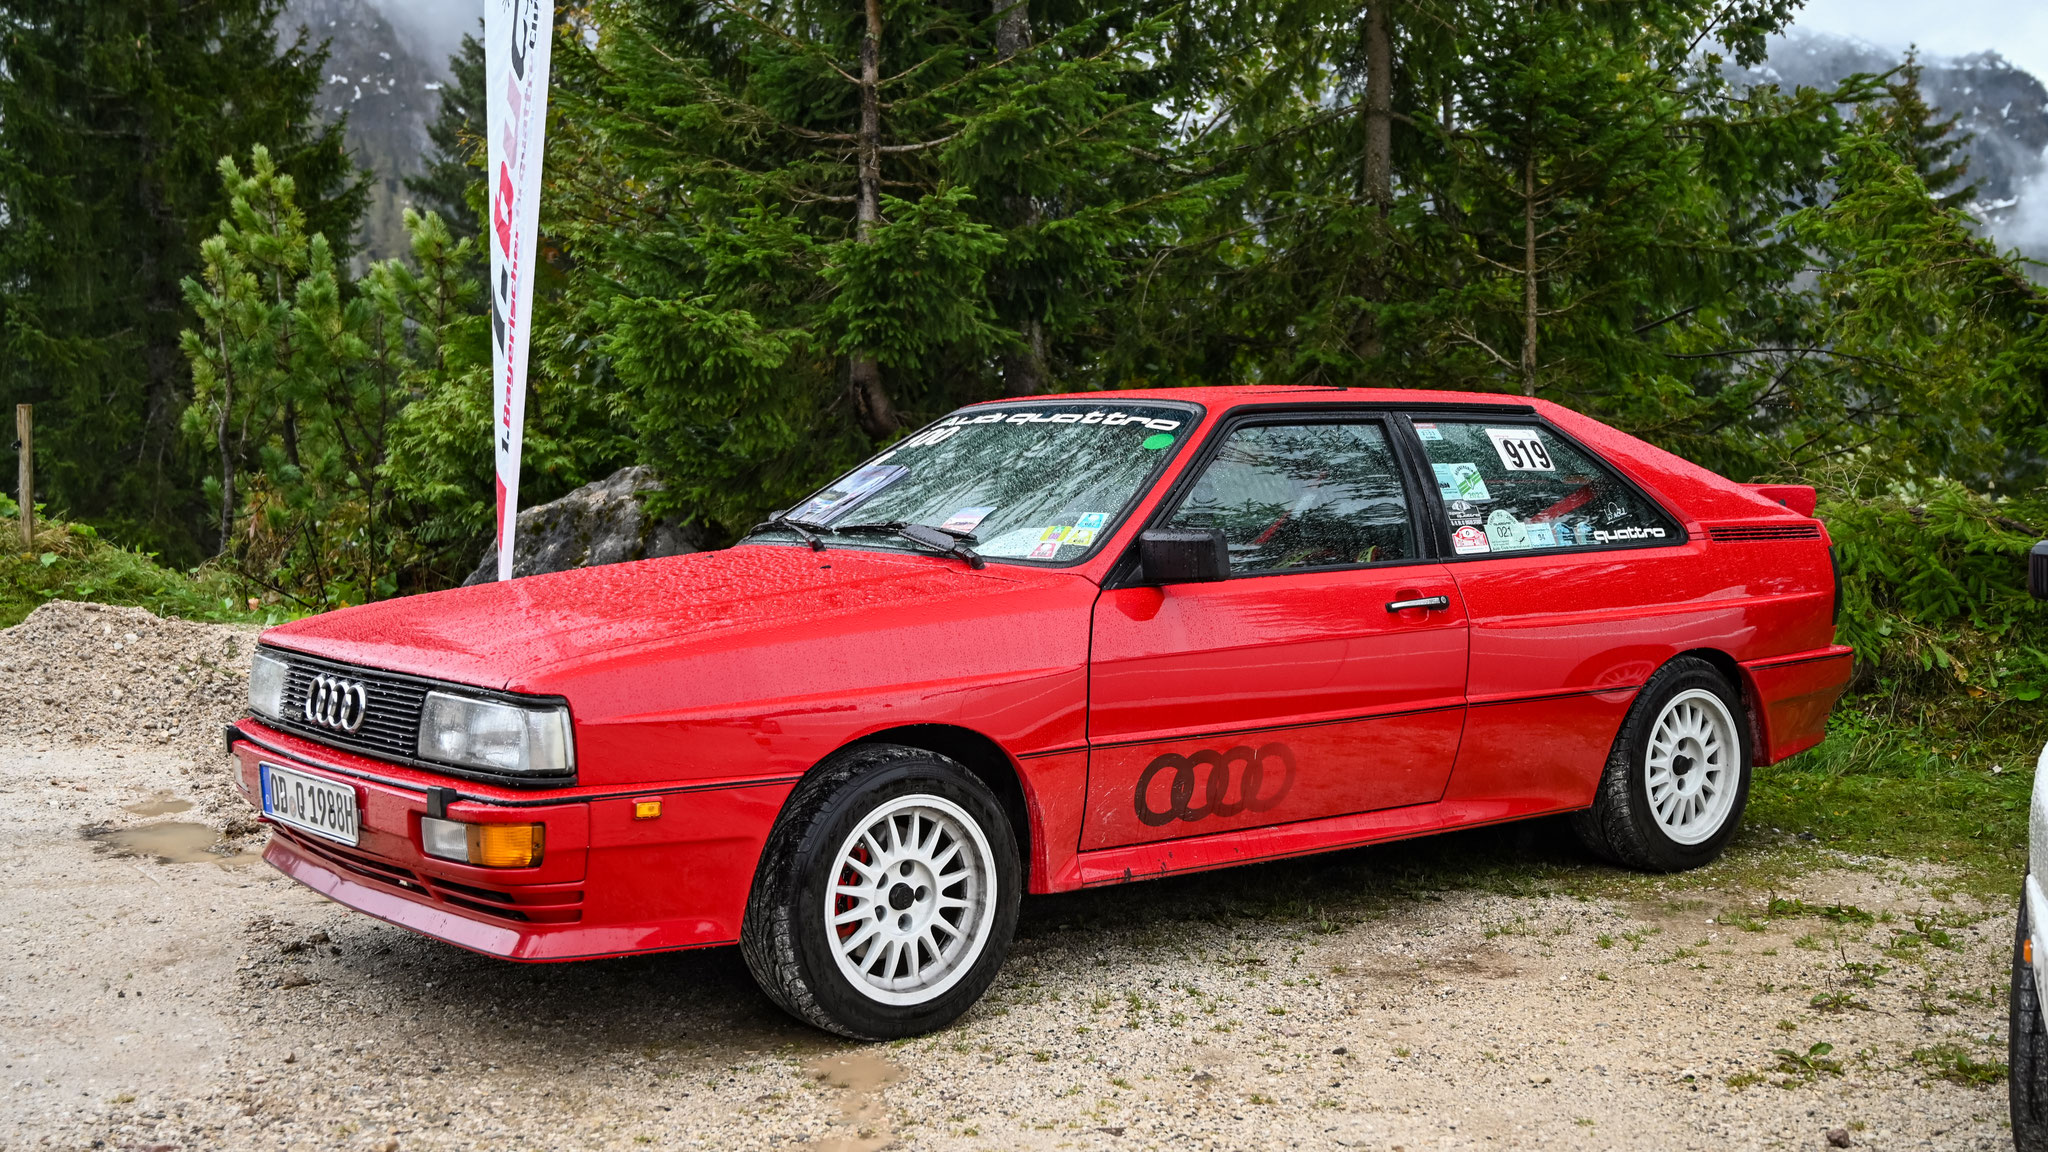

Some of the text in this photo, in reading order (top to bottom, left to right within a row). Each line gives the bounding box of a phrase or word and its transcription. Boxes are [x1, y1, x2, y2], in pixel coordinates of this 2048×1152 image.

[1005, 411, 1181, 431] quattro
[1502, 439, 1551, 469] 919
[1496, 526, 1513, 538] 021
[1593, 526, 1666, 543] quattro
[295, 781, 306, 821] Q
[307, 785, 356, 837] 1988H
